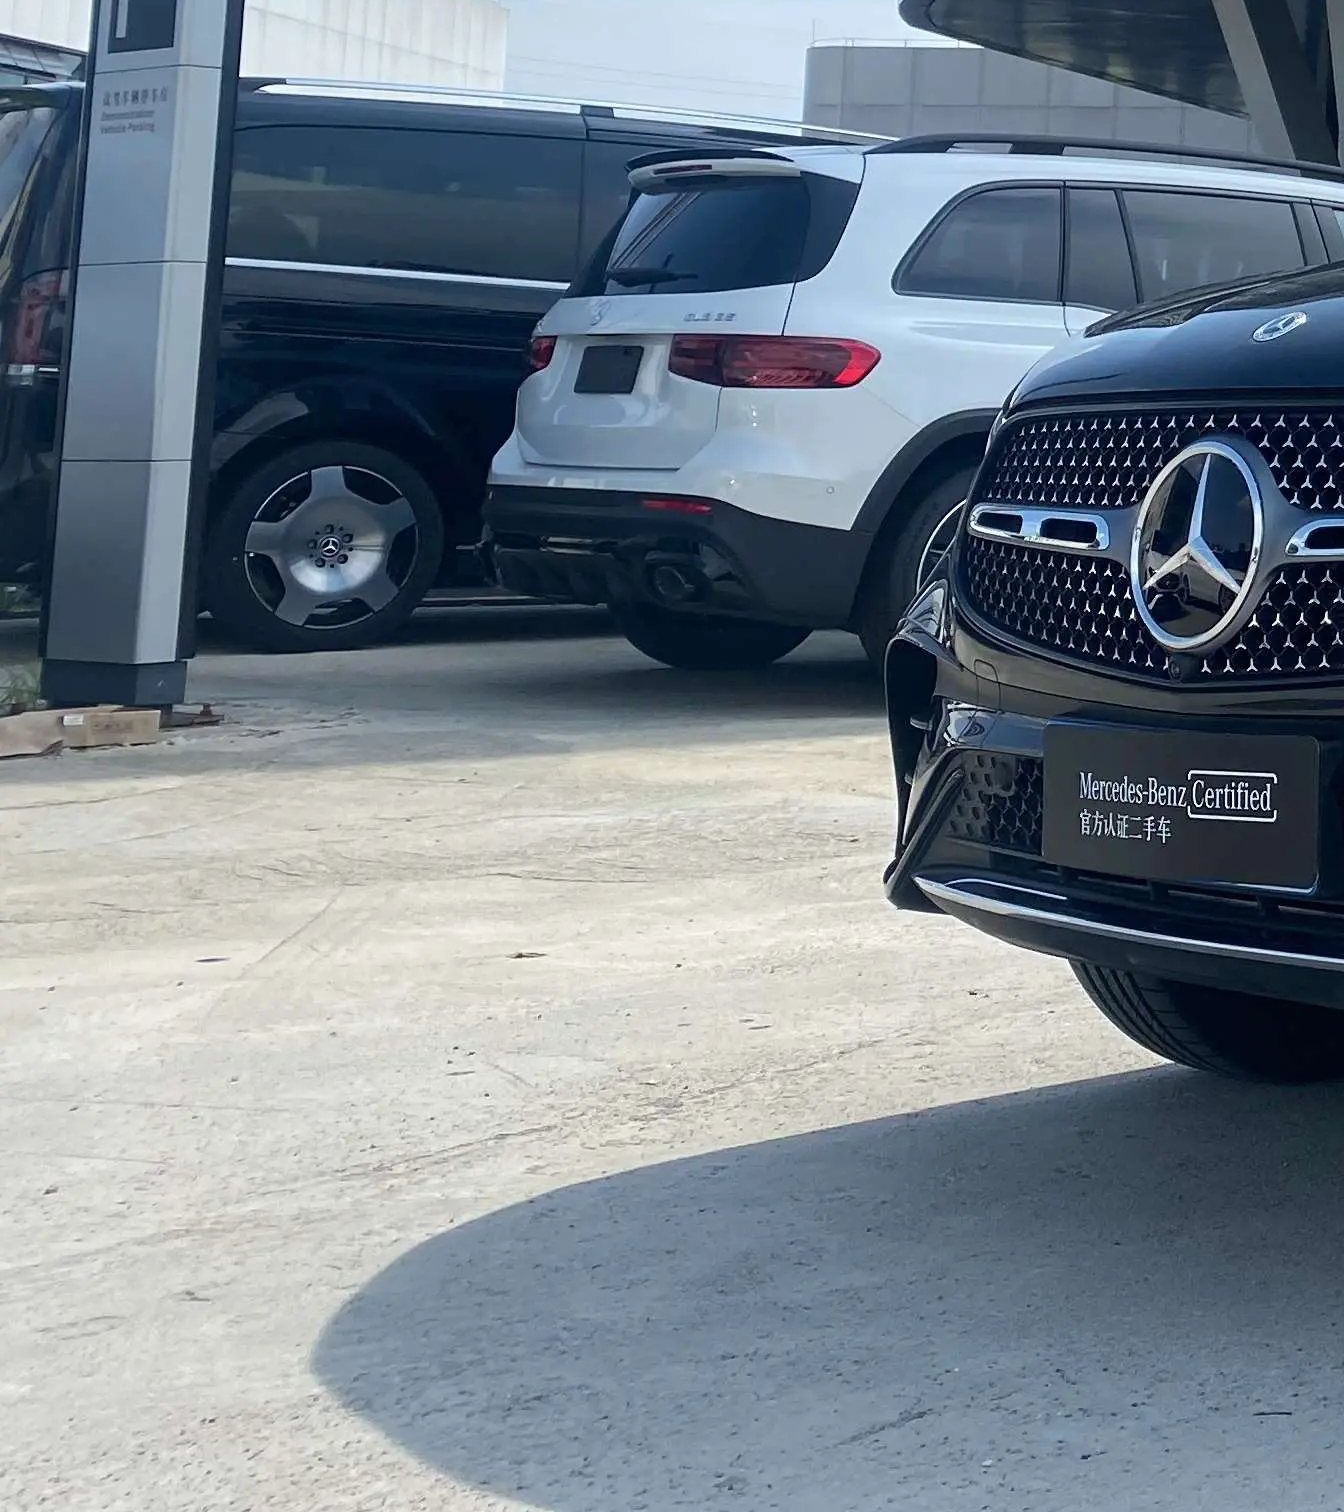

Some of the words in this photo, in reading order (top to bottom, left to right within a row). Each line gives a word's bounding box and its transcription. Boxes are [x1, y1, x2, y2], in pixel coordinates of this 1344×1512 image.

[1079, 771, 1187, 808] Mercedes-Benz
[1191, 779, 1272, 812] Certified
[1079, 807, 1172, 844] 官方认证二手车
